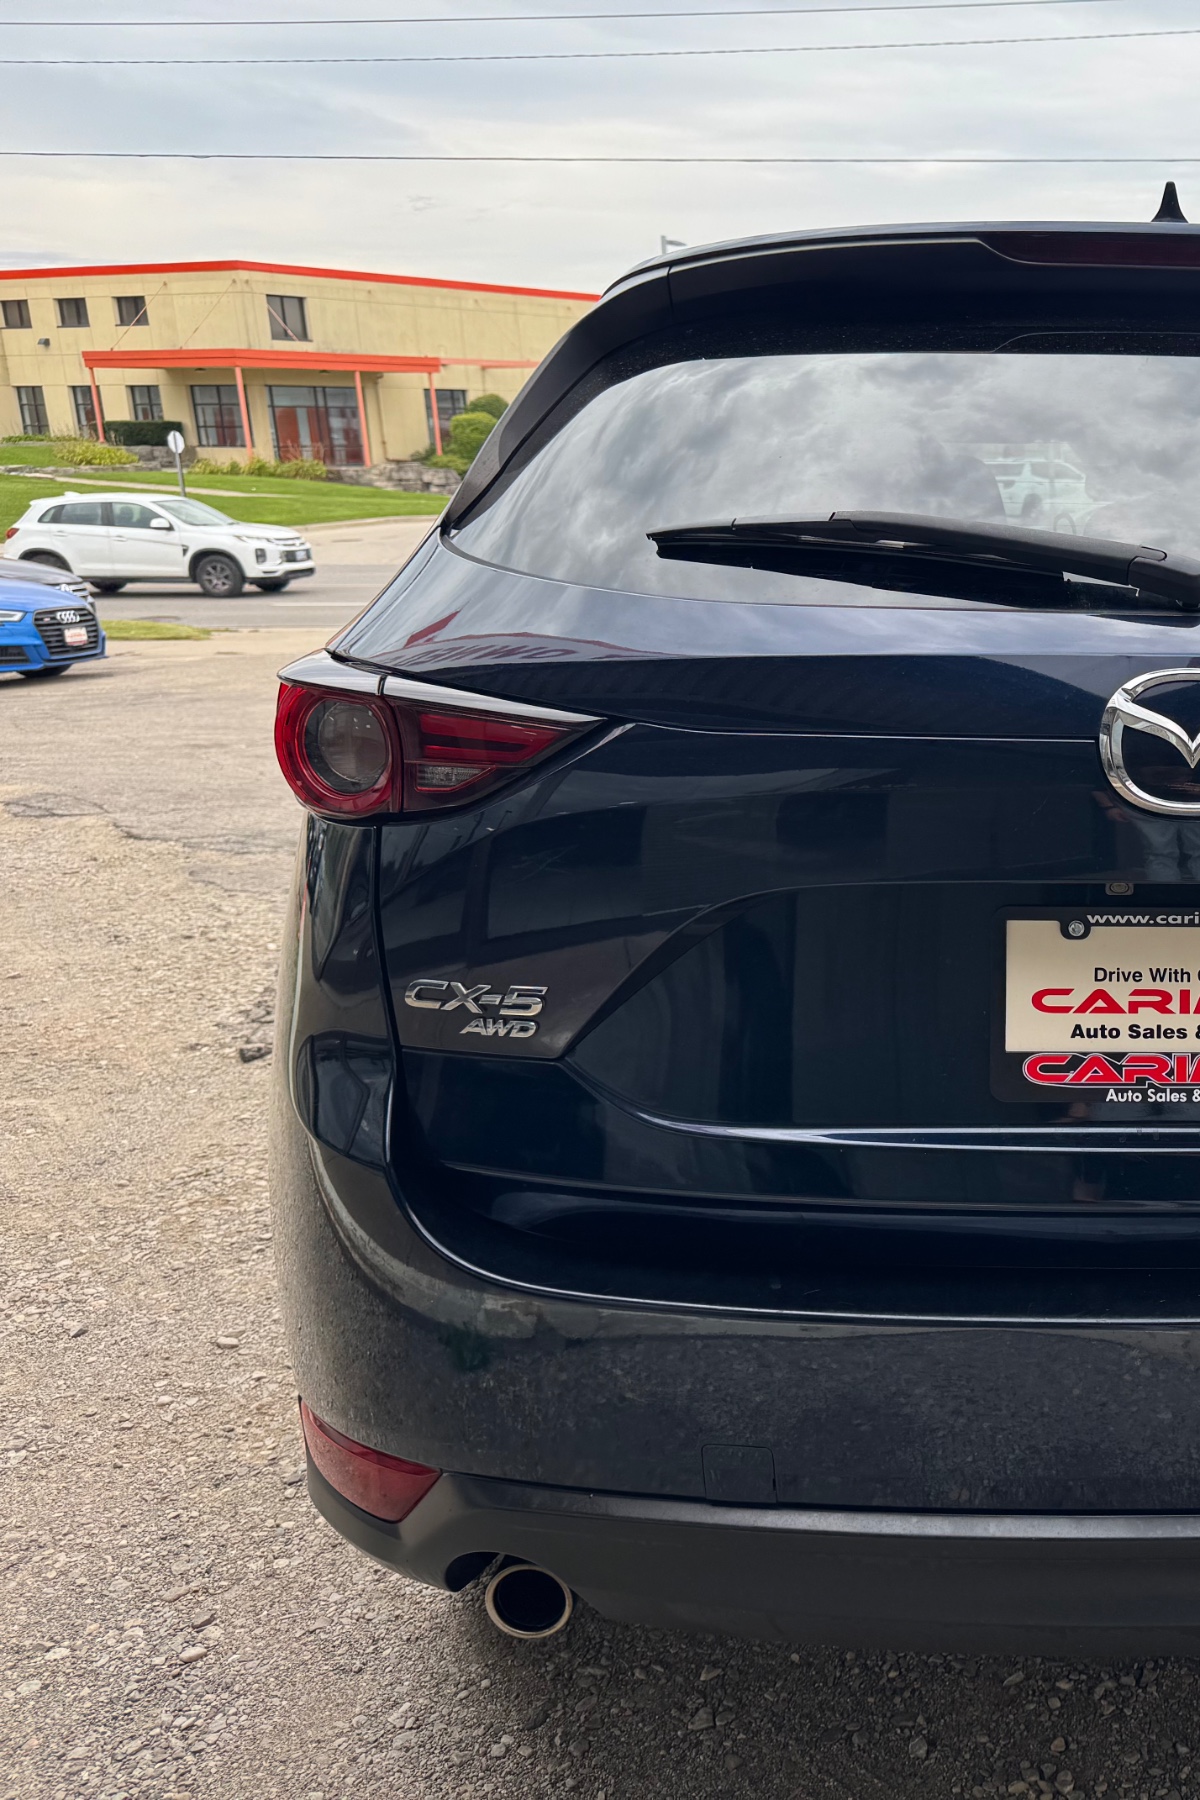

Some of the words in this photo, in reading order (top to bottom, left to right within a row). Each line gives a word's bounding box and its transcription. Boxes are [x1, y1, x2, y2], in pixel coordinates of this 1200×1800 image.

[1094, 967, 1143, 983] Drive
[1149, 967, 1191, 983] With
[404, 979, 548, 1016] CX-5
[459, 1018, 537, 1037] AWD
[1070, 1024, 1121, 1040] Auto
[1128, 1024, 1188, 1040] Sales
[1106, 1088, 1143, 1103] Auto
[1147, 1088, 1188, 1103] Sales
